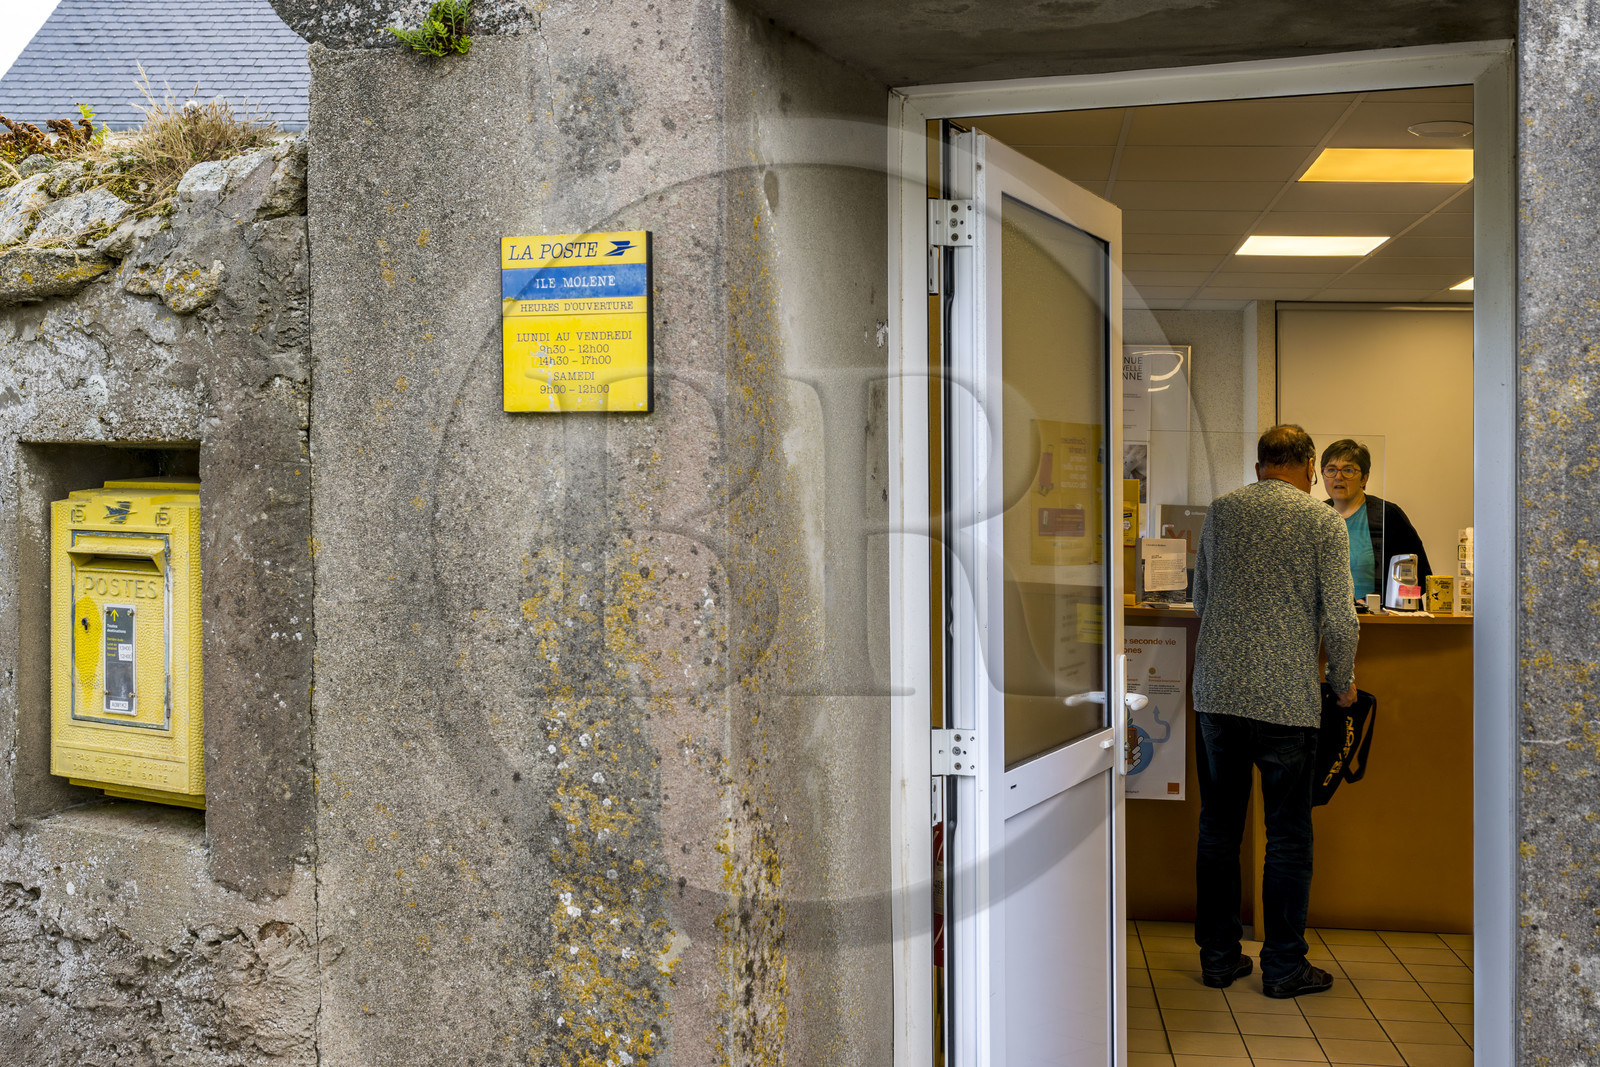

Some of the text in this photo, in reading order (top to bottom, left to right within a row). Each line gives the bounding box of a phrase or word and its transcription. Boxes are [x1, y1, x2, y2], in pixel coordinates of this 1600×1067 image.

[508, 241, 598, 261] LA POSTE
[535, 275, 616, 289] ILE MOLENE
[520, 301, 634, 312] HEURES D'OUVERTURE
[517, 331, 632, 343] LUNDI AU VENDREDI
[539, 344, 566, 354] 9h30
[578, 344, 609, 353] 12h00
[539, 356, 568, 365] 14h30
[581, 355, 611, 365] 17h00
[553, 371, 595, 382] SAMEDI
[539, 385, 566, 394] 9h00
[578, 384, 610, 394] 12h00
[83, 575, 158, 599] POSTES
[1129, 637, 1163, 646] seconde
[1165, 637, 1177, 646] vie
[75, 752, 90, 762] PAS
[105, 767, 132, 779] CETTE
